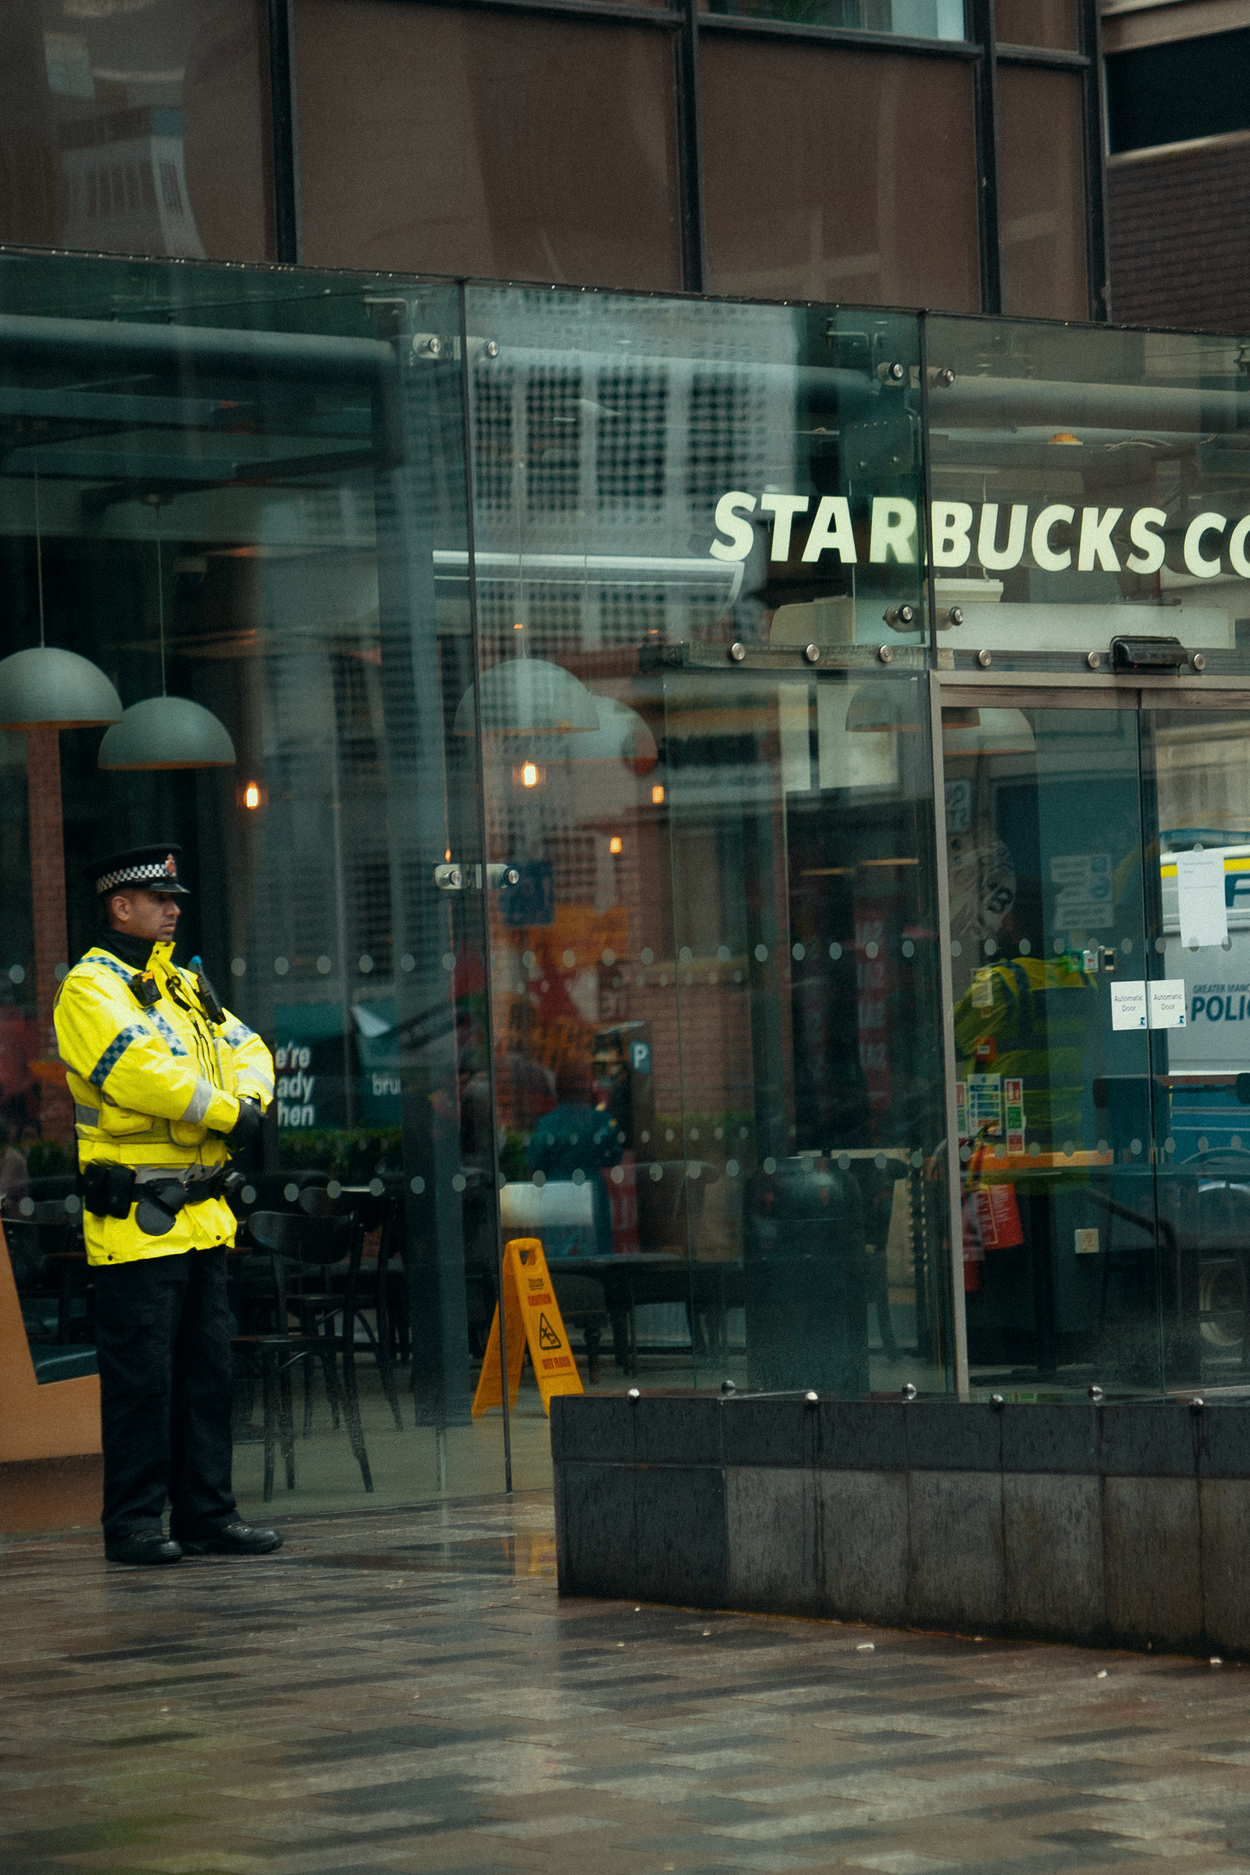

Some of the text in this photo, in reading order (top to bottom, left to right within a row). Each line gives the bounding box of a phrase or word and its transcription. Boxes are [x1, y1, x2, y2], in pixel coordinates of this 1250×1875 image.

[709, 491, 1167, 574] STARBUCKS
[1153, 993, 1182, 1001] Automatic
[1192, 983, 1226, 995] GREATER
[1121, 1004, 1136, 1012] Door
[1161, 1003, 1176, 1011] Door
[275, 1041, 310, 1069] e're
[634, 1043, 648, 1069] P
[277, 1070, 314, 1103] ady
[372, 1073, 400, 1095] bru
[277, 1101, 314, 1126] hen
